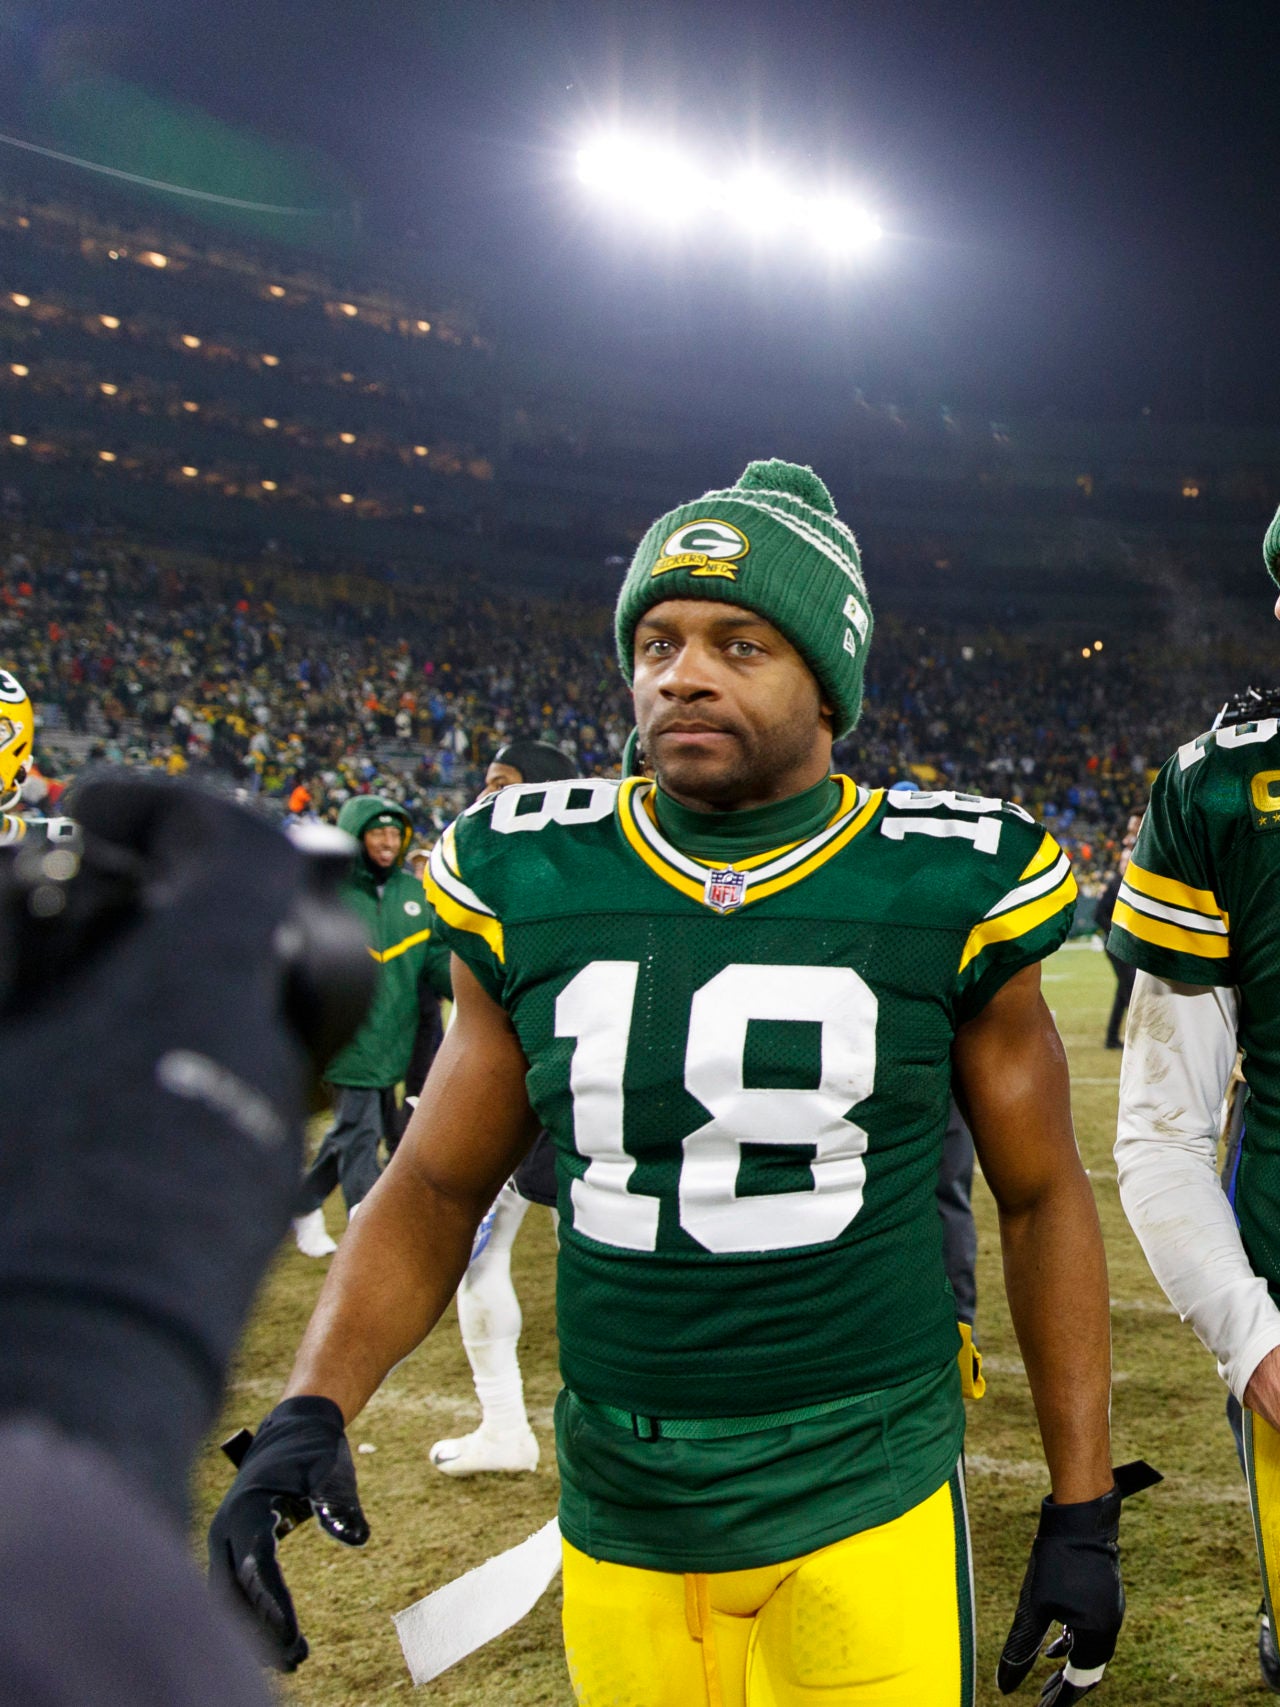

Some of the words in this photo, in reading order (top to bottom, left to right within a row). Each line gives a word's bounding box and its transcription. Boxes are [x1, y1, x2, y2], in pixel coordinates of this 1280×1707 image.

[665, 522, 742, 558] G
[706, 563, 729, 573] NFC
[711, 885, 738, 904] NFL
[555, 960, 878, 1253] 18
